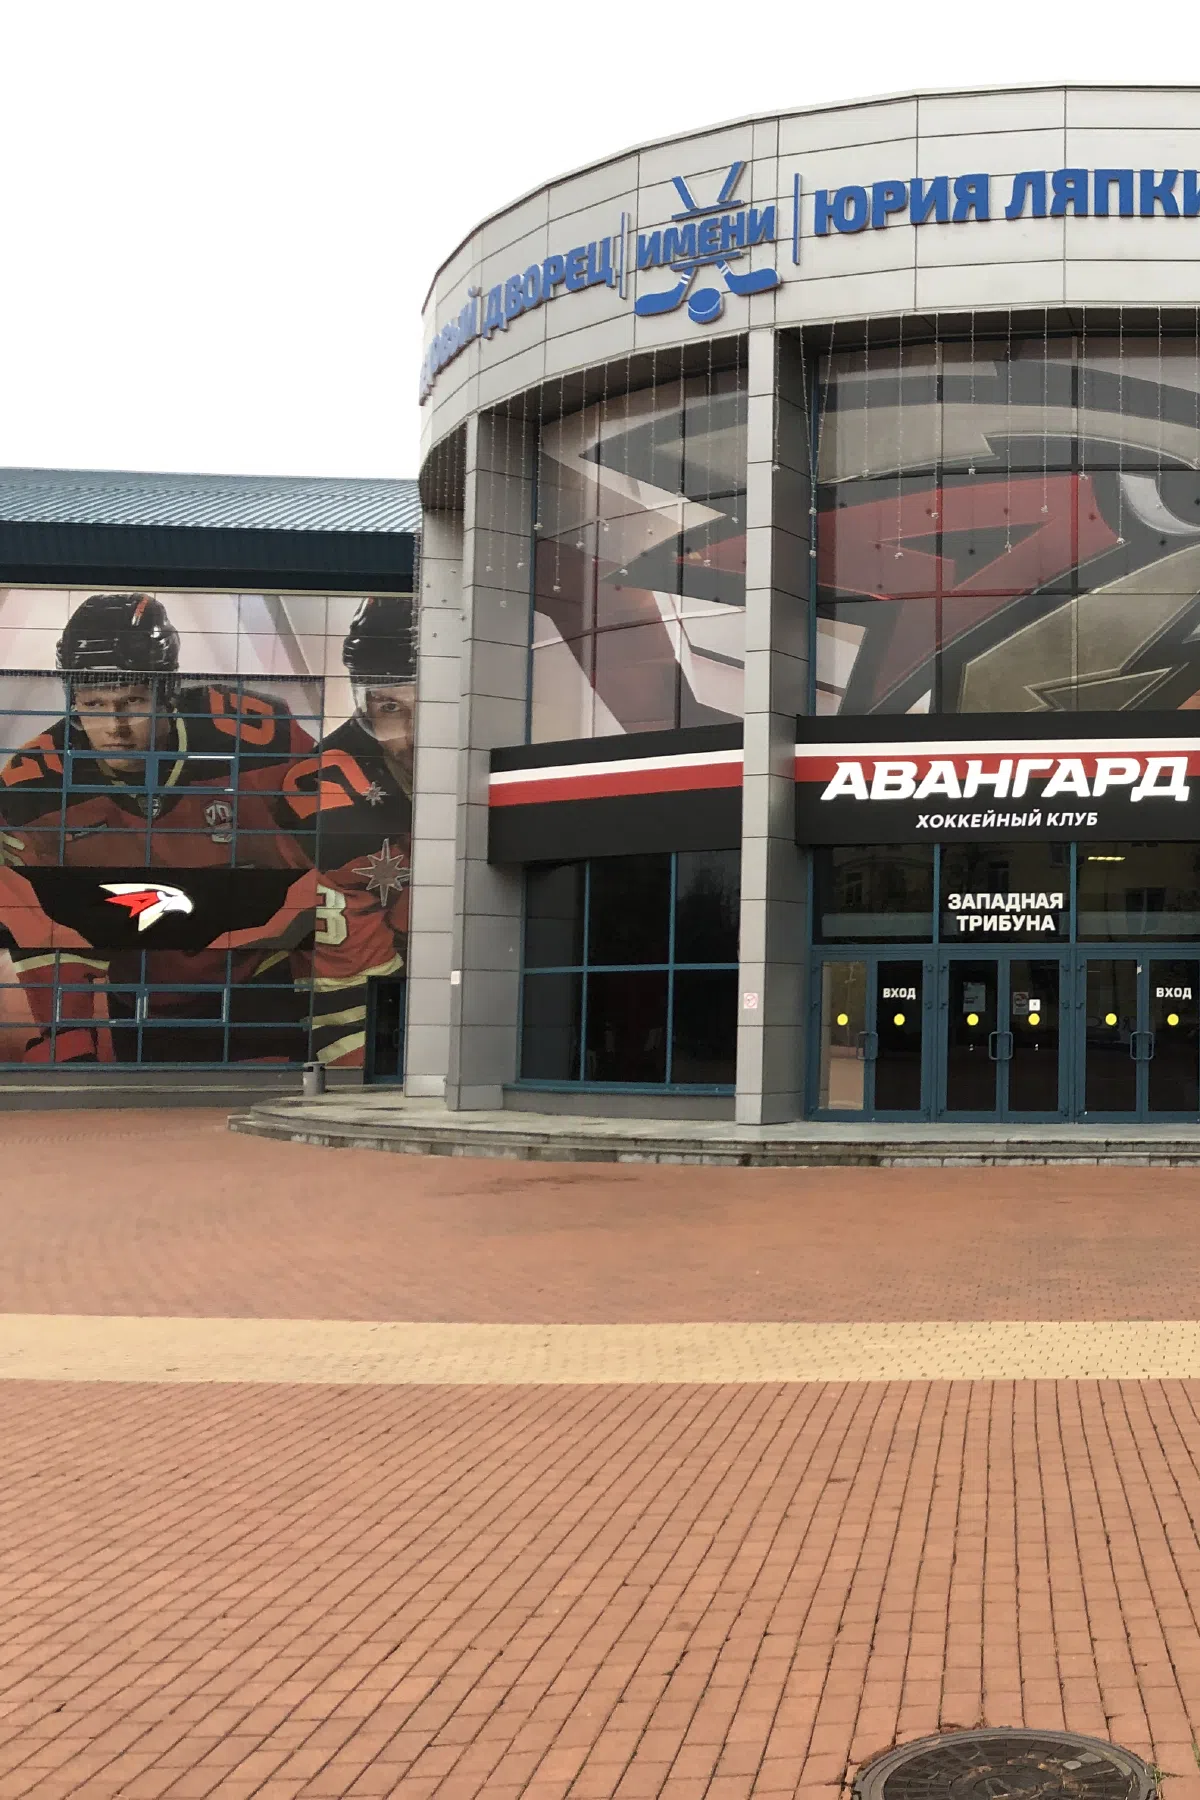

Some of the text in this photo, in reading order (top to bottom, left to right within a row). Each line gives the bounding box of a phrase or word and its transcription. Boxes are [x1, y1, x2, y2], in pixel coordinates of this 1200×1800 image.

[482, 235, 616, 340] ДВОРЕЦ
[637, 205, 777, 270] ИМЕНИ
[814, 172, 991, 236] ЮРИЯ
[820, 756, 1190, 802] АВАНГАРД
[915, 809, 1098, 829] ХОККЕЙНЫЙ КЛУБ
[948, 892, 1064, 912] ЗАПАДНАЯ
[956, 914, 1056, 932] ТРИБУНА
[883, 987, 916, 1000] ВХОД
[1156, 986, 1192, 1000] ВХОД
